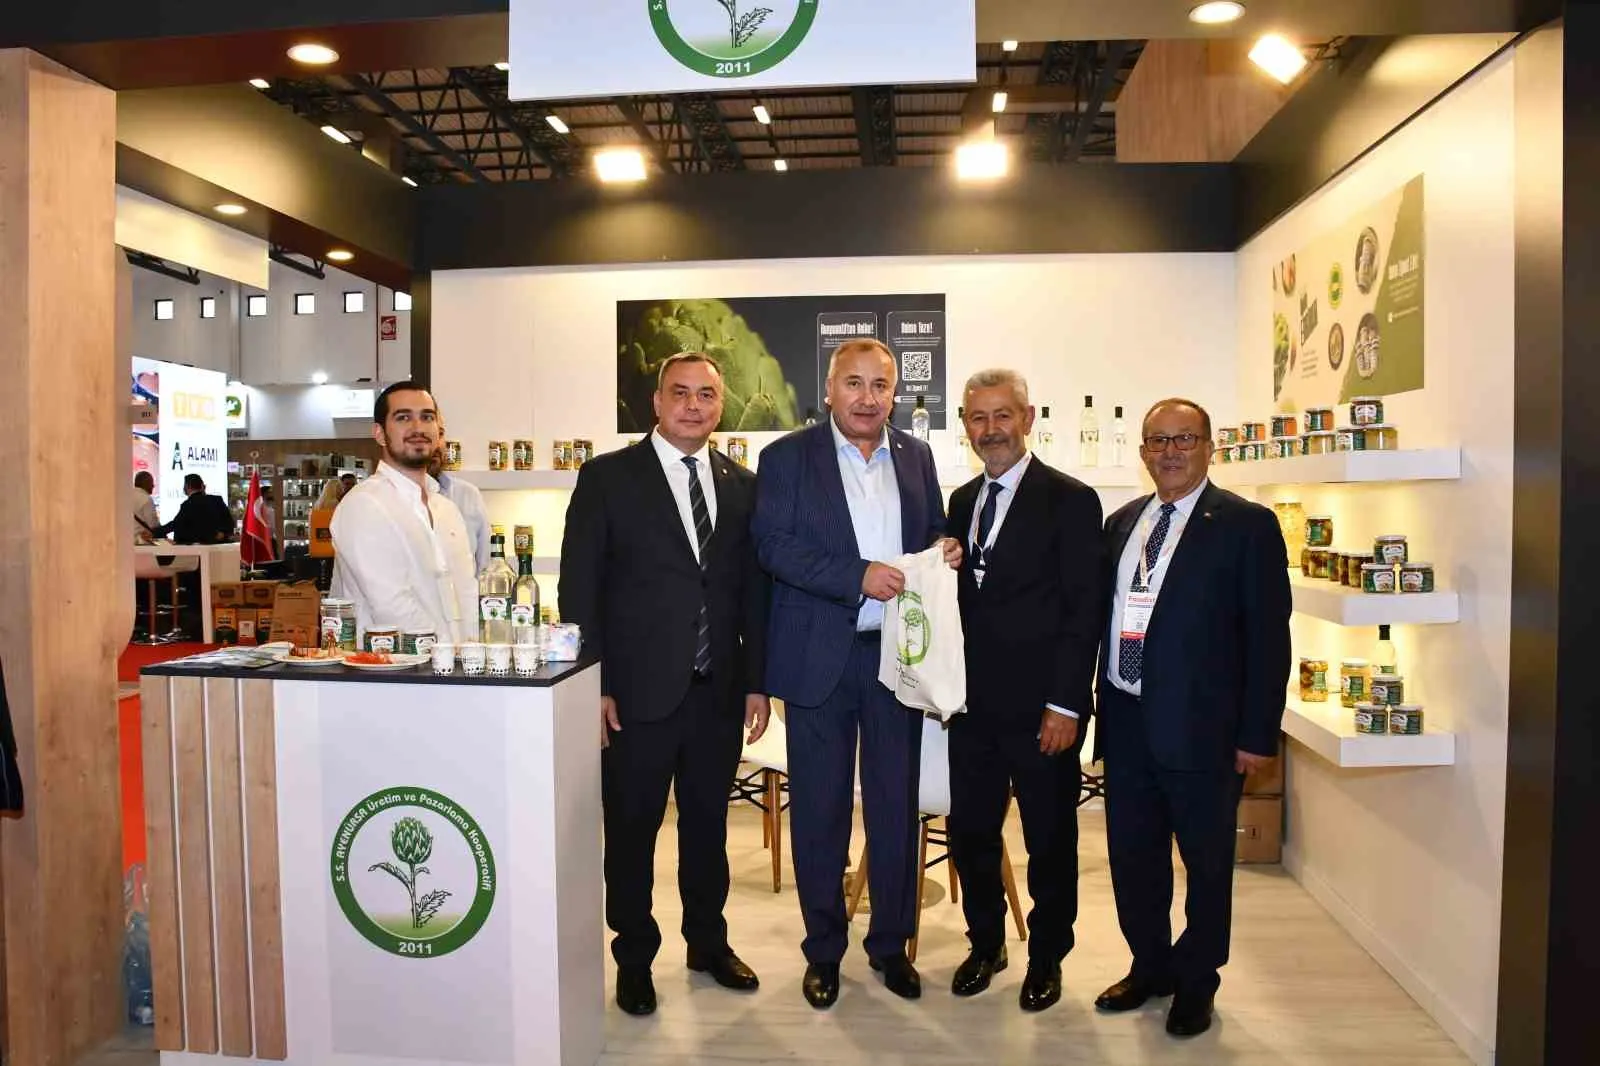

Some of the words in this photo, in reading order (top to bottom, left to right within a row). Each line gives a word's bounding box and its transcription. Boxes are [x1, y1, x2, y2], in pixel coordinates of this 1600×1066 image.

[715, 61, 752, 75] 2011
[187, 446, 218, 462] ALAMI
[335, 862, 346, 883] S.S.
[367, 793, 402, 812] Üretim
[403, 793, 417, 802] ve
[419, 793, 470, 831] Pazarlama
[467, 829, 492, 892] Kooperatifi
[398, 941, 433, 955] 2011
